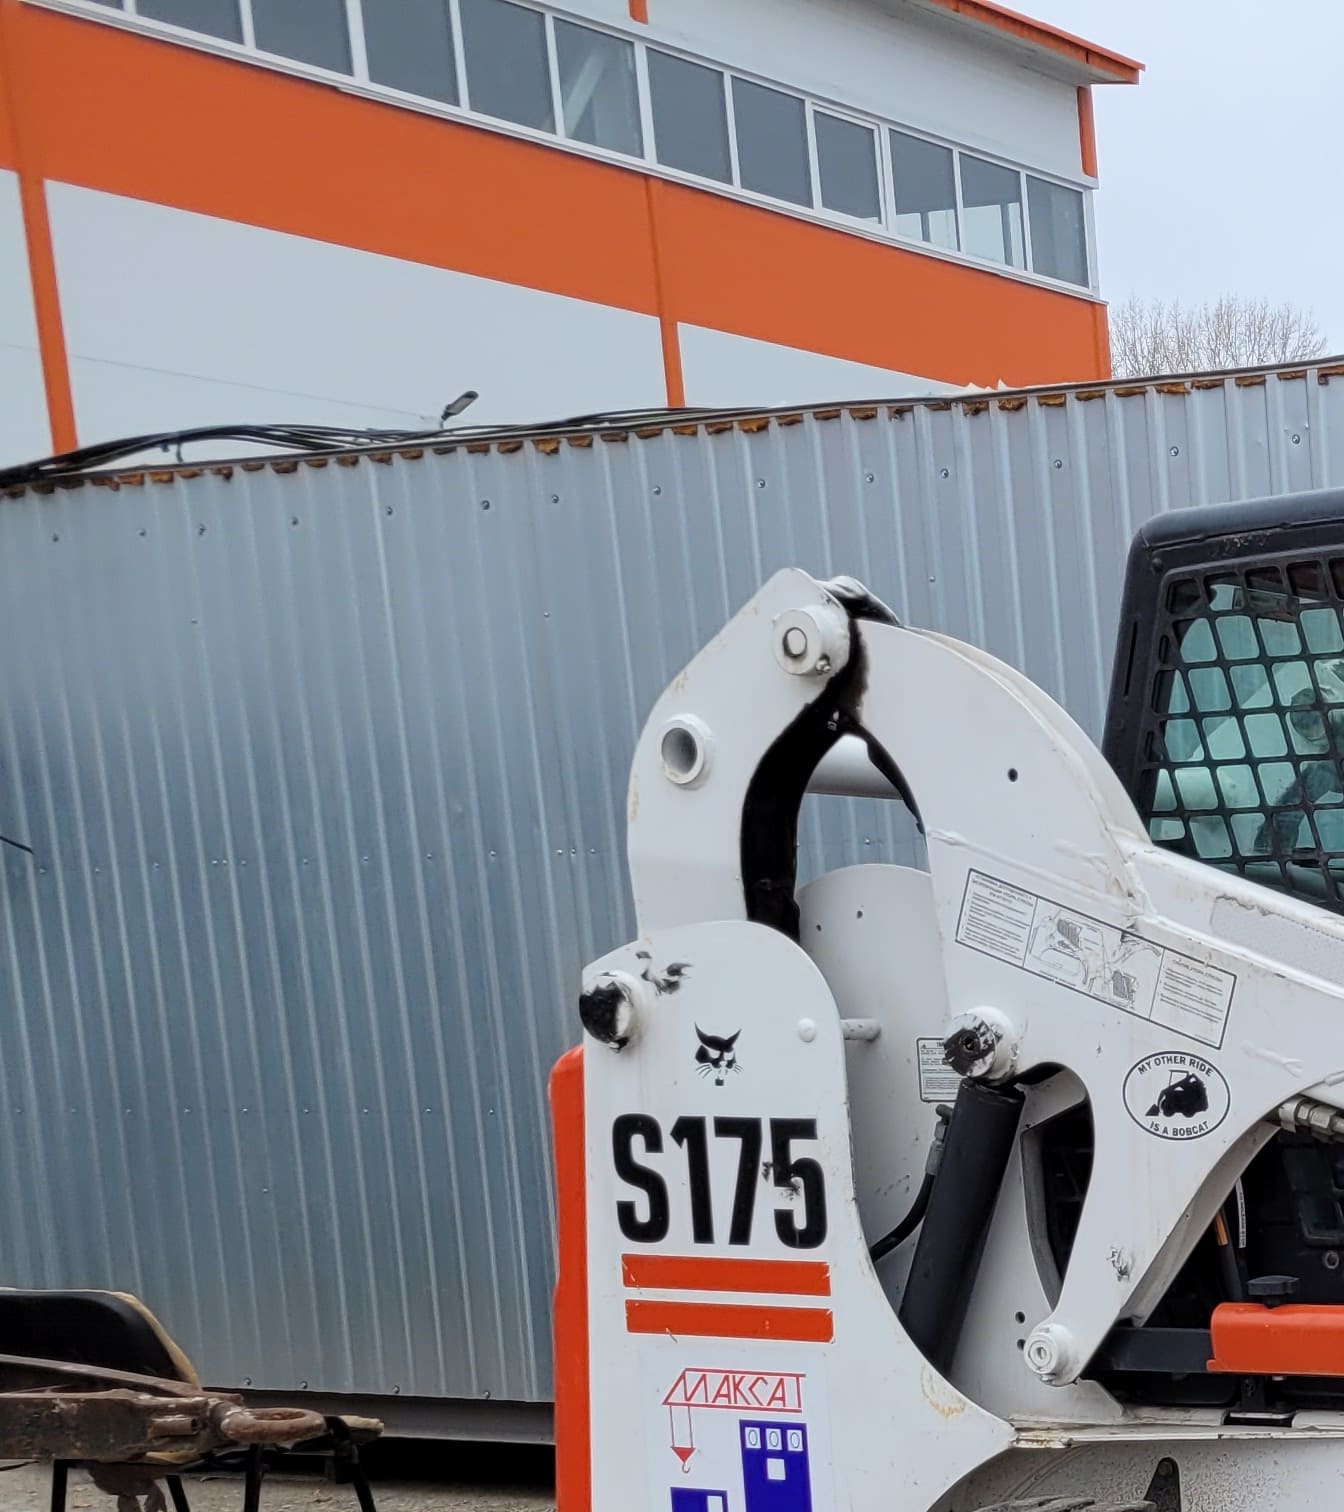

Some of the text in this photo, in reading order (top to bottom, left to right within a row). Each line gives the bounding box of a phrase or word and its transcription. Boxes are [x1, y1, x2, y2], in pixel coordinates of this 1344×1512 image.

[1137, 1055, 1214, 1077] MY OTHER RIDE
[1149, 1120, 1209, 1137] IS A BOBCAT
[612, 1113, 828, 1249] S175
[663, 1367, 806, 1413] МАКСАТ
